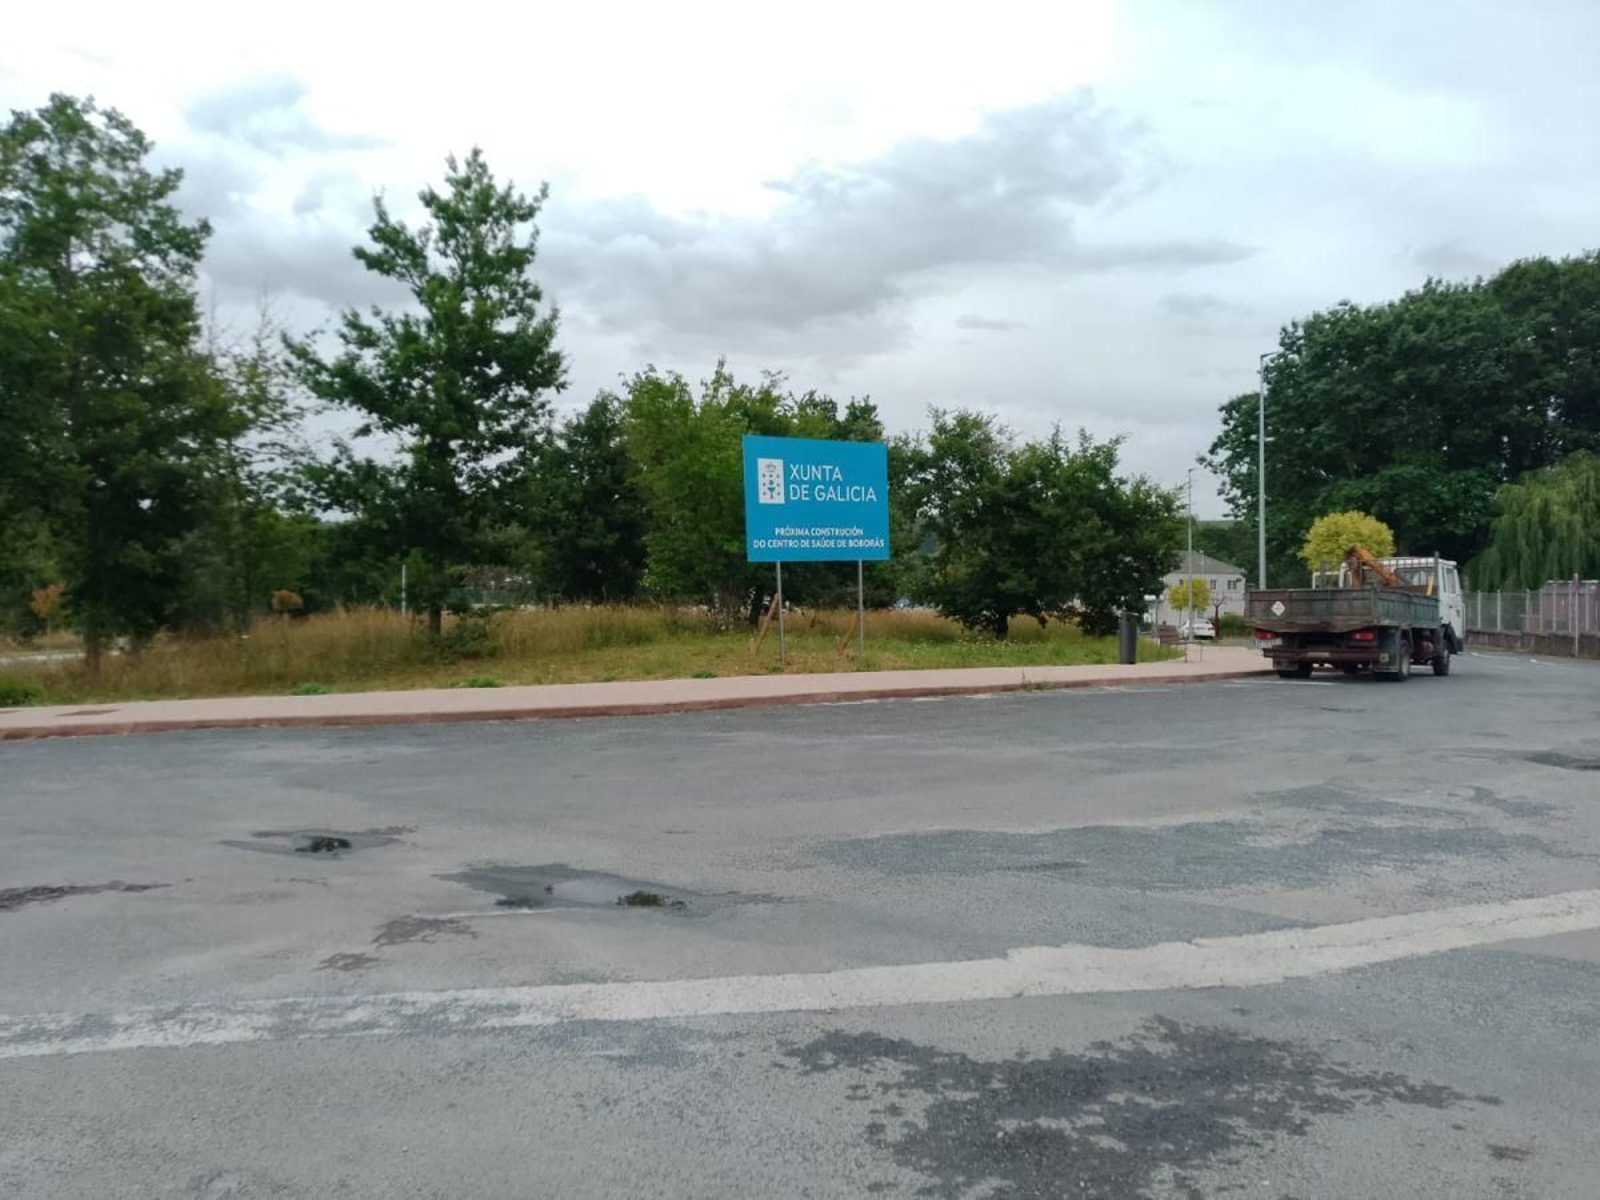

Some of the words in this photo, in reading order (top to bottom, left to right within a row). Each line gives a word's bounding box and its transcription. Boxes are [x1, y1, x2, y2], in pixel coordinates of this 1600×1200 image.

[789, 464, 843, 481] XUNTA
[789, 484, 810, 500] DE
[815, 486, 877, 502] GALICIA
[775, 525, 809, 536] PRÓXIMA
[810, 525, 863, 536] CONSTRUCIÓN
[753, 540, 766, 548] DO
[767, 539, 799, 548] CENTRO
[800, 540, 810, 548] DE
[811, 537, 835, 548] SAÚDE
[837, 540, 846, 548] DE
[849, 537, 884, 548] BOBORÁS
